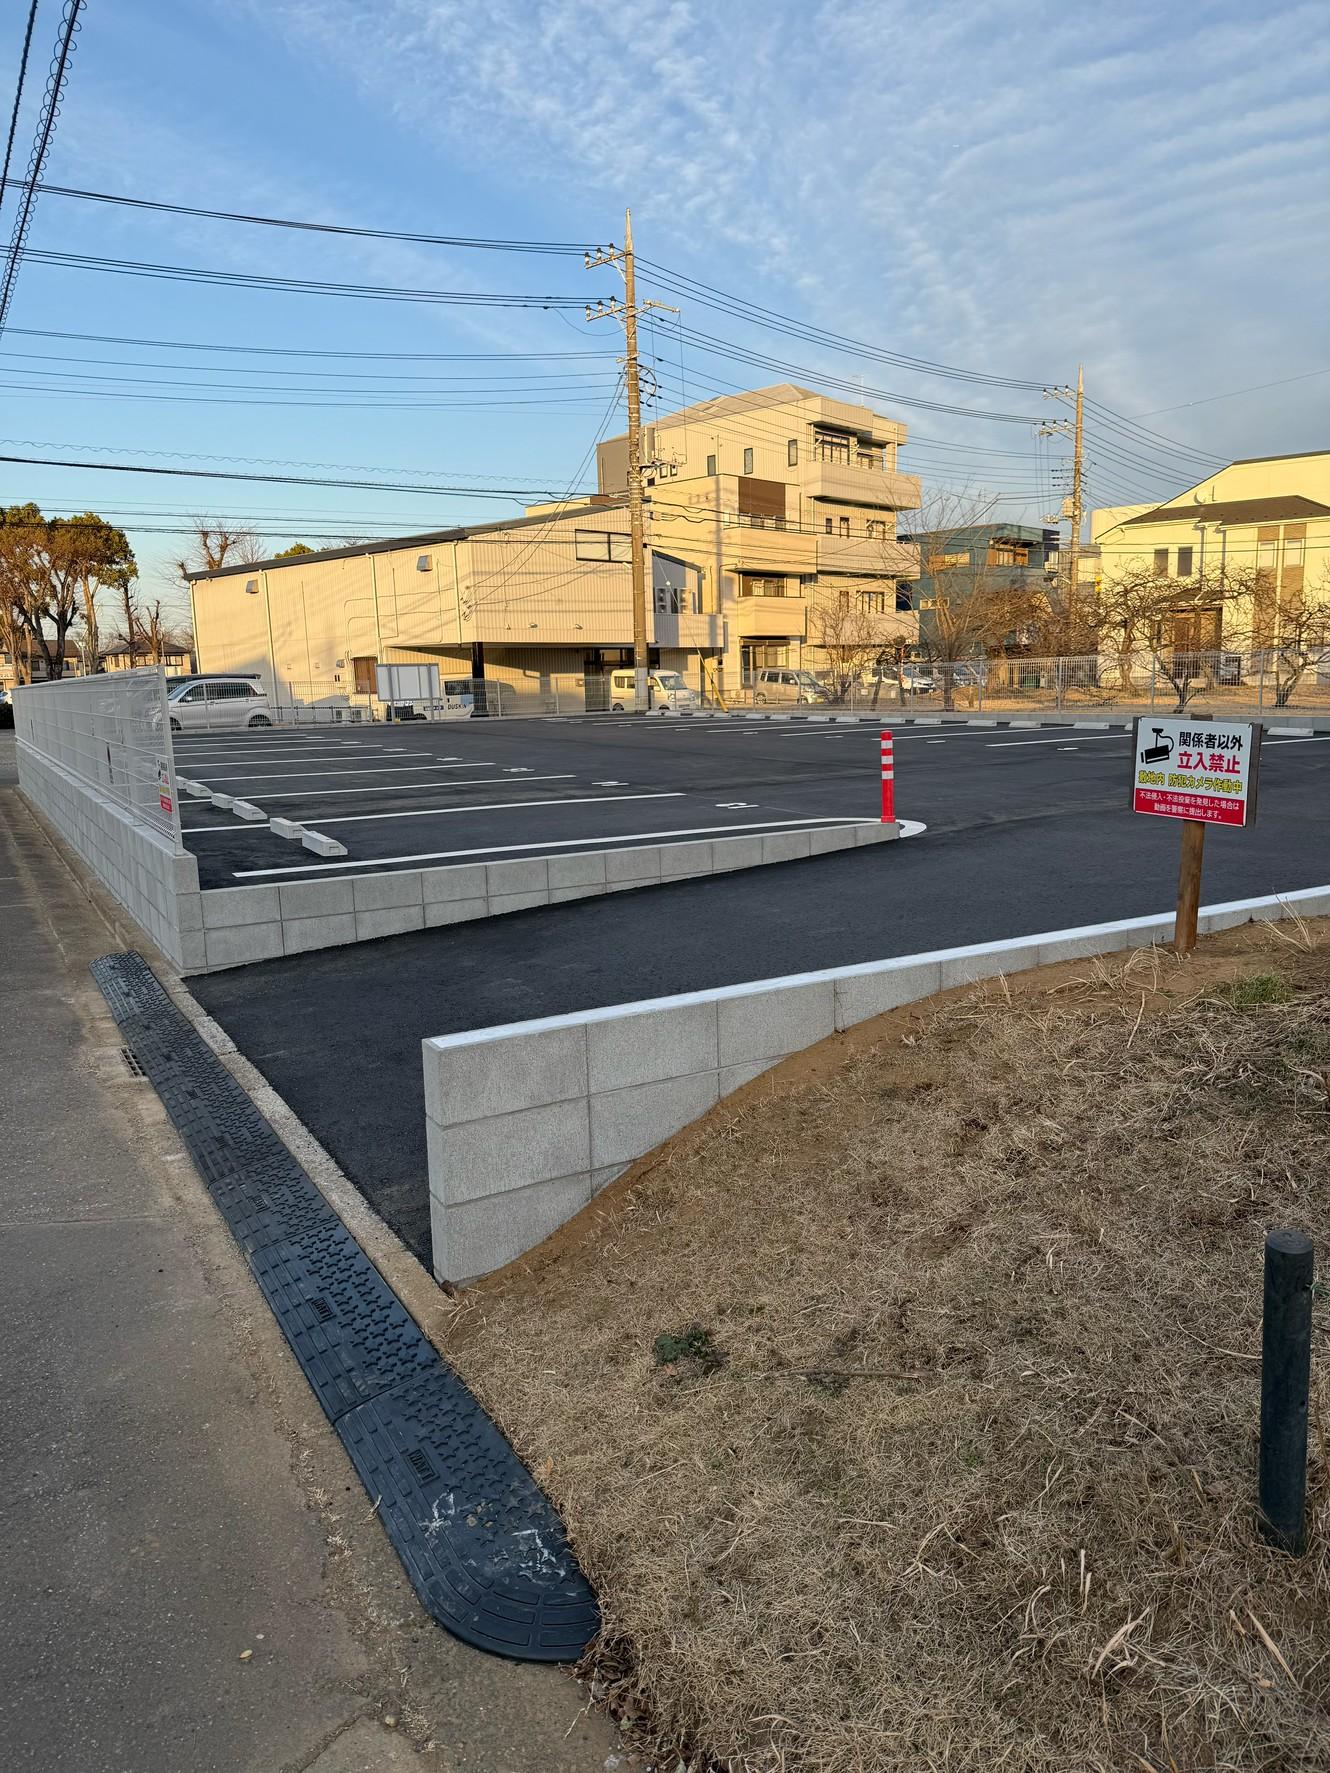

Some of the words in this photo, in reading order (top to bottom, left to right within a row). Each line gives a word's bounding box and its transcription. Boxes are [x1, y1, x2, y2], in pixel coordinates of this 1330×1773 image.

[1179, 731, 1243, 751] 関係者以外
[1177, 751, 1241, 774] 立入禁止
[1138, 770, 1165, 786] 敷地内
[1167, 773, 1243, 794] 防犯カメラ作動中
